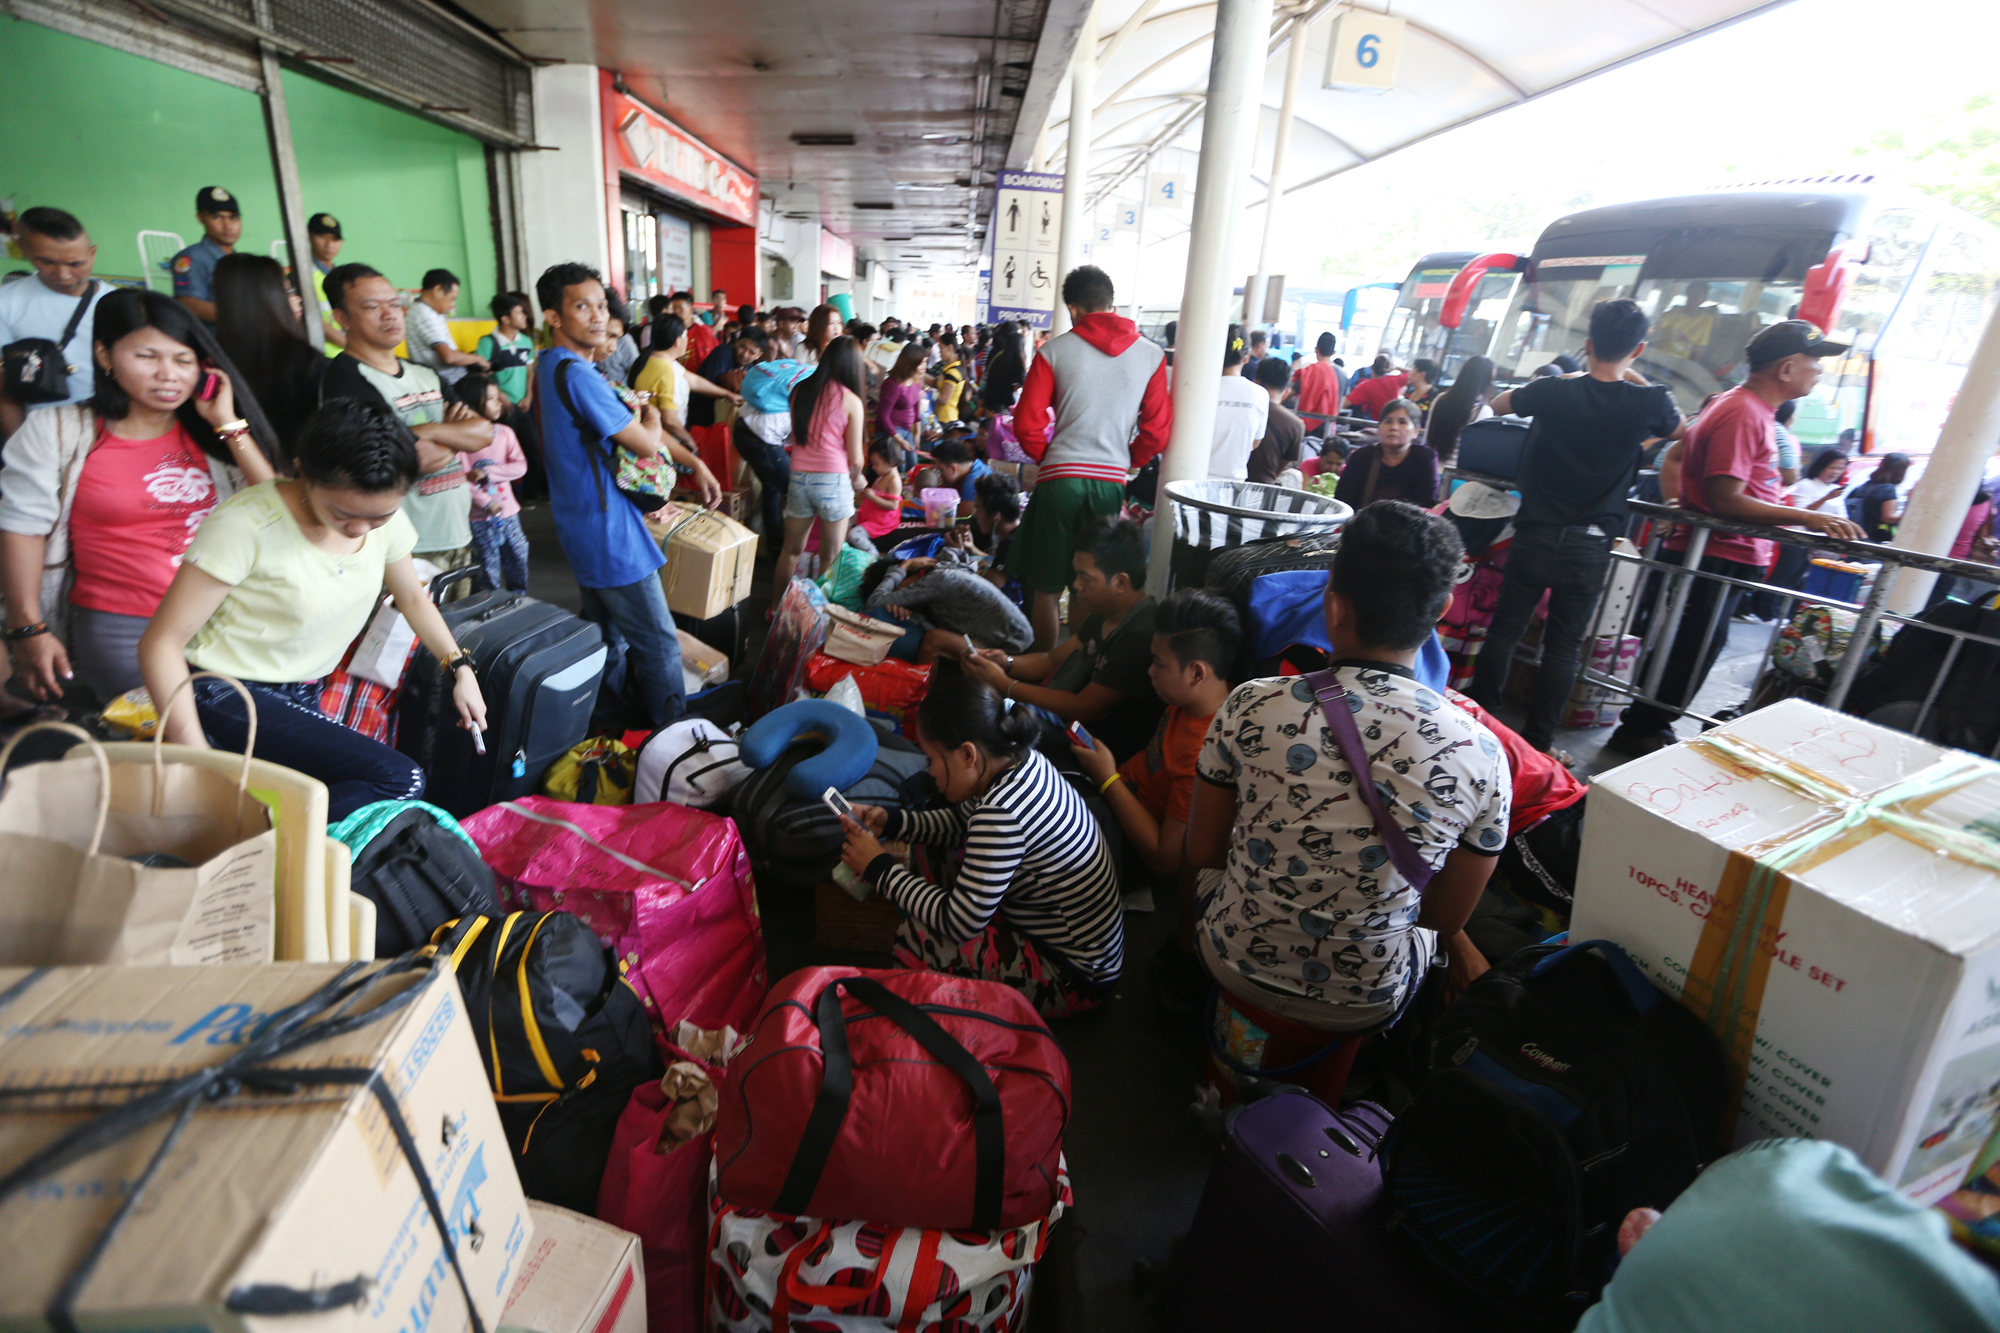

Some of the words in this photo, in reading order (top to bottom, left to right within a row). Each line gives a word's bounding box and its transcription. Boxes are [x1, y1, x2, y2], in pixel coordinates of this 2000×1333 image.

[1356, 33, 1381, 68] 6
[1003, 173, 1064, 190] BOARDING
[1161, 181, 1174, 199] 4
[1100, 228, 1110, 241] 2
[1124, 211, 1135, 225] 3
[1083, 243, 1089, 254] 1
[998, 310, 1047, 324] PRIORITY
[1675, 877, 1732, 913] HEAVY
[1628, 865, 1684, 907] 10PCS.
[1690, 904, 1803, 971] CASOLE
[1807, 965, 1848, 994] SET
[1776, 1049, 1832, 1088] COVER
[1771, 1067, 1827, 1107] COVER
[1767, 1085, 1821, 1125] COVER
[419, 1131, 470, 1228] Sunre
